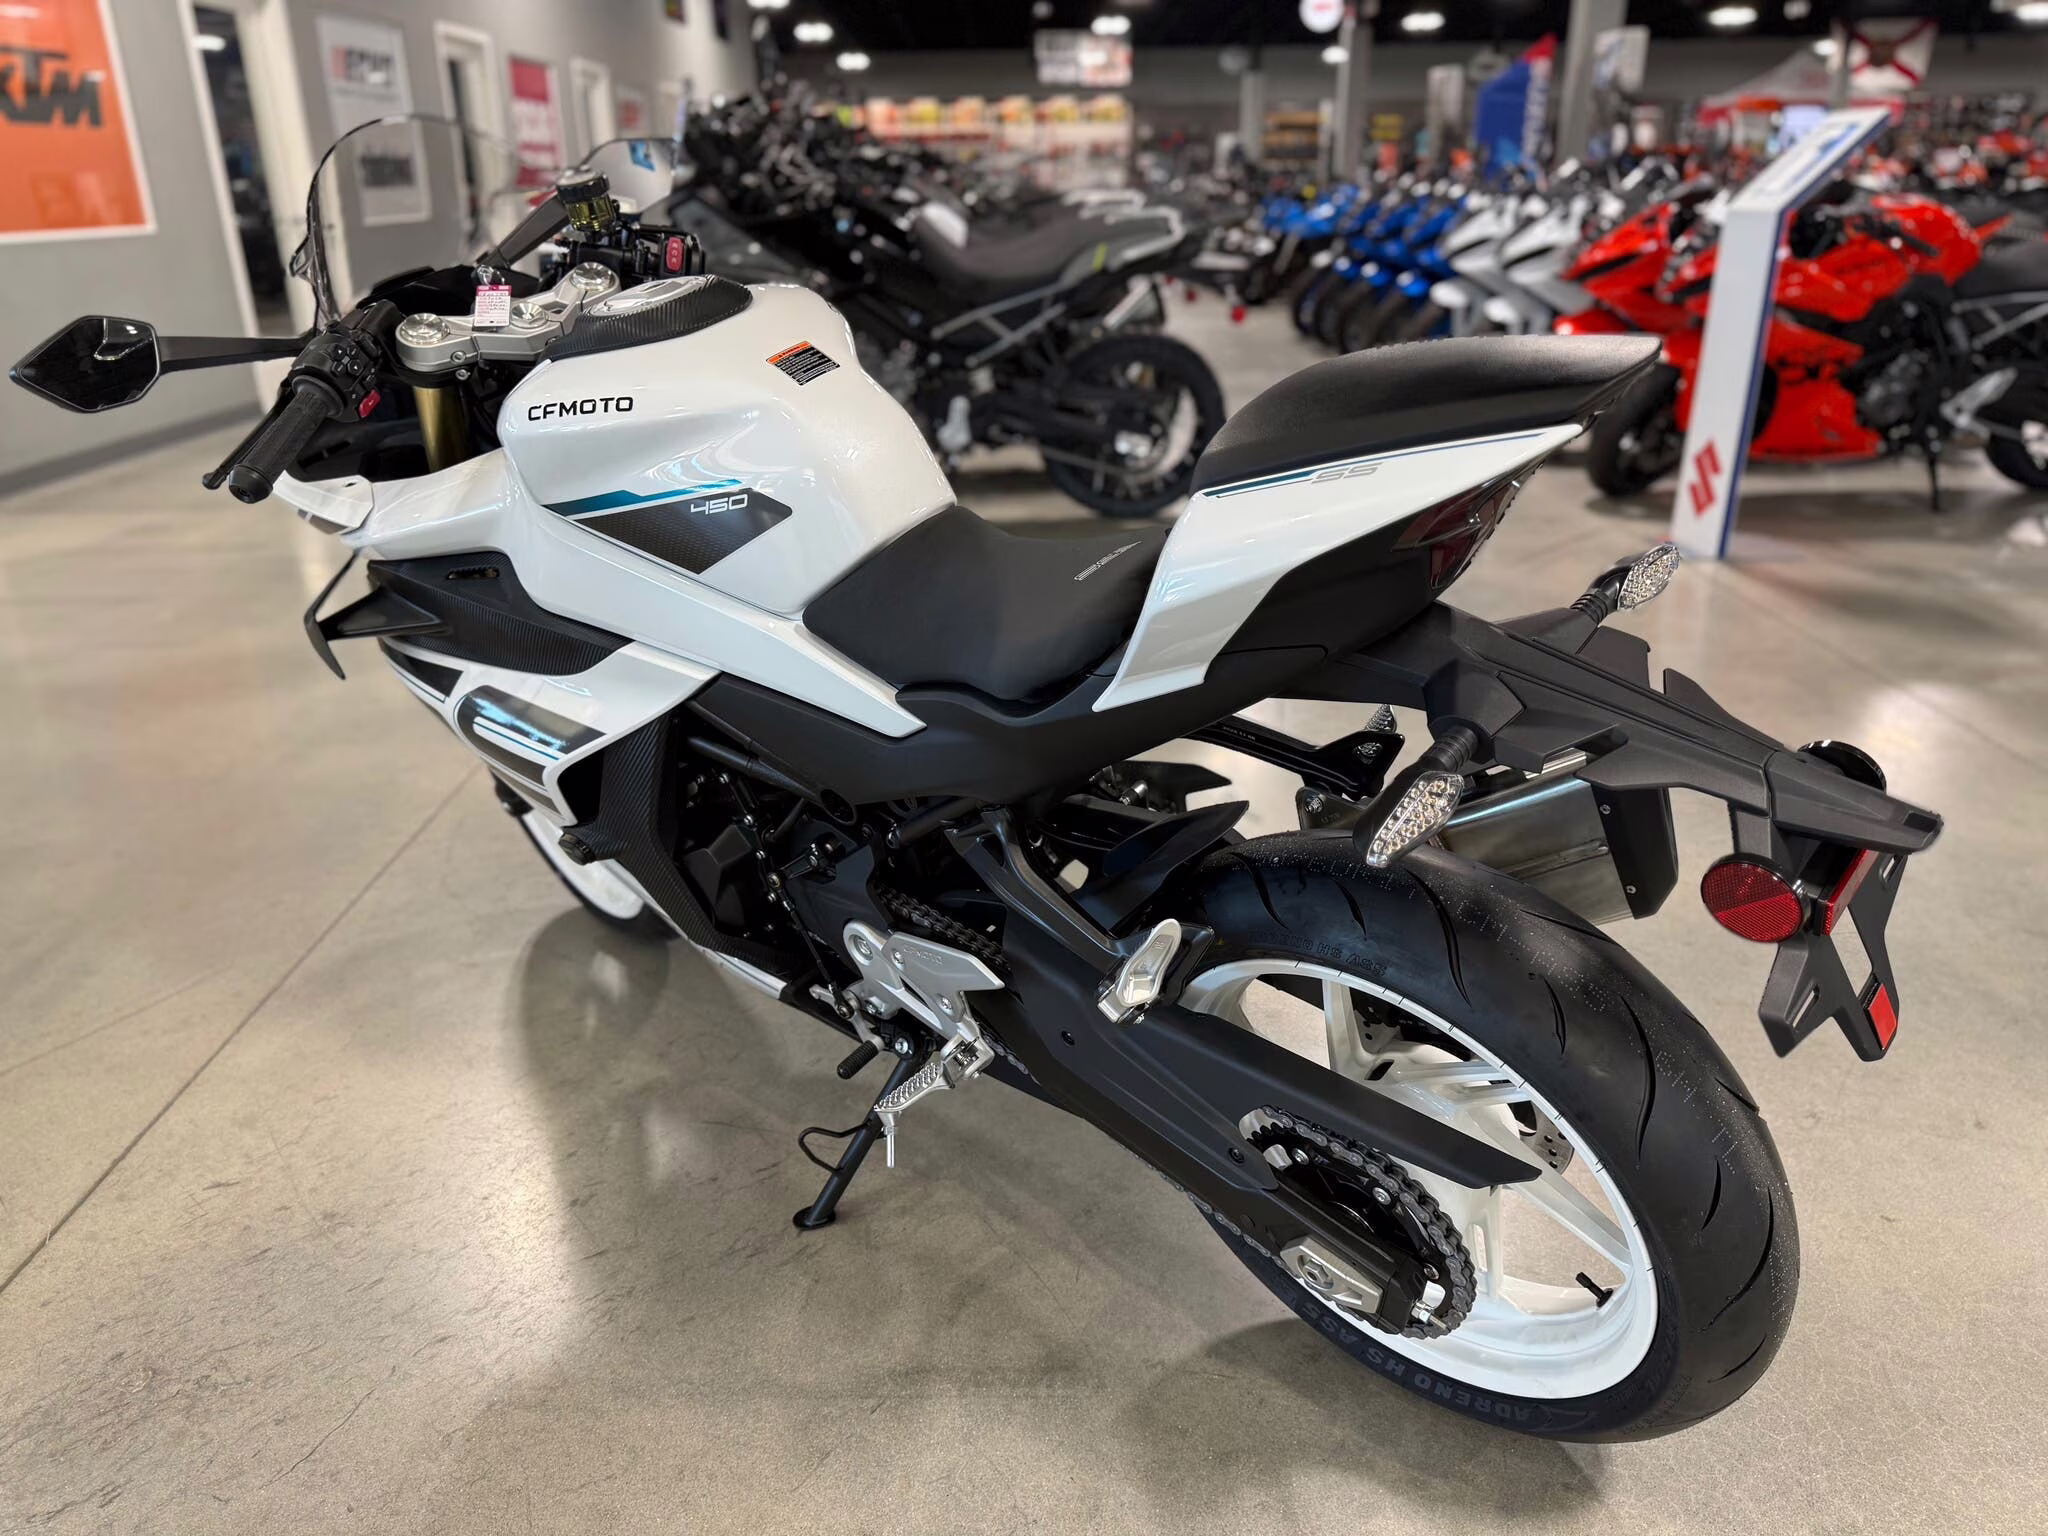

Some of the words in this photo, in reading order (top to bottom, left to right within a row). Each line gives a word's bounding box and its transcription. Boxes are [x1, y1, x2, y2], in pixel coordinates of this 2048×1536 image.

[528, 397, 633, 421] CFMOTO
[1311, 462, 1384, 484] SS
[691, 494, 748, 514] 450
[1366, 1346, 1406, 1377] HS
[1413, 1372, 1532, 1422] ADRENO
